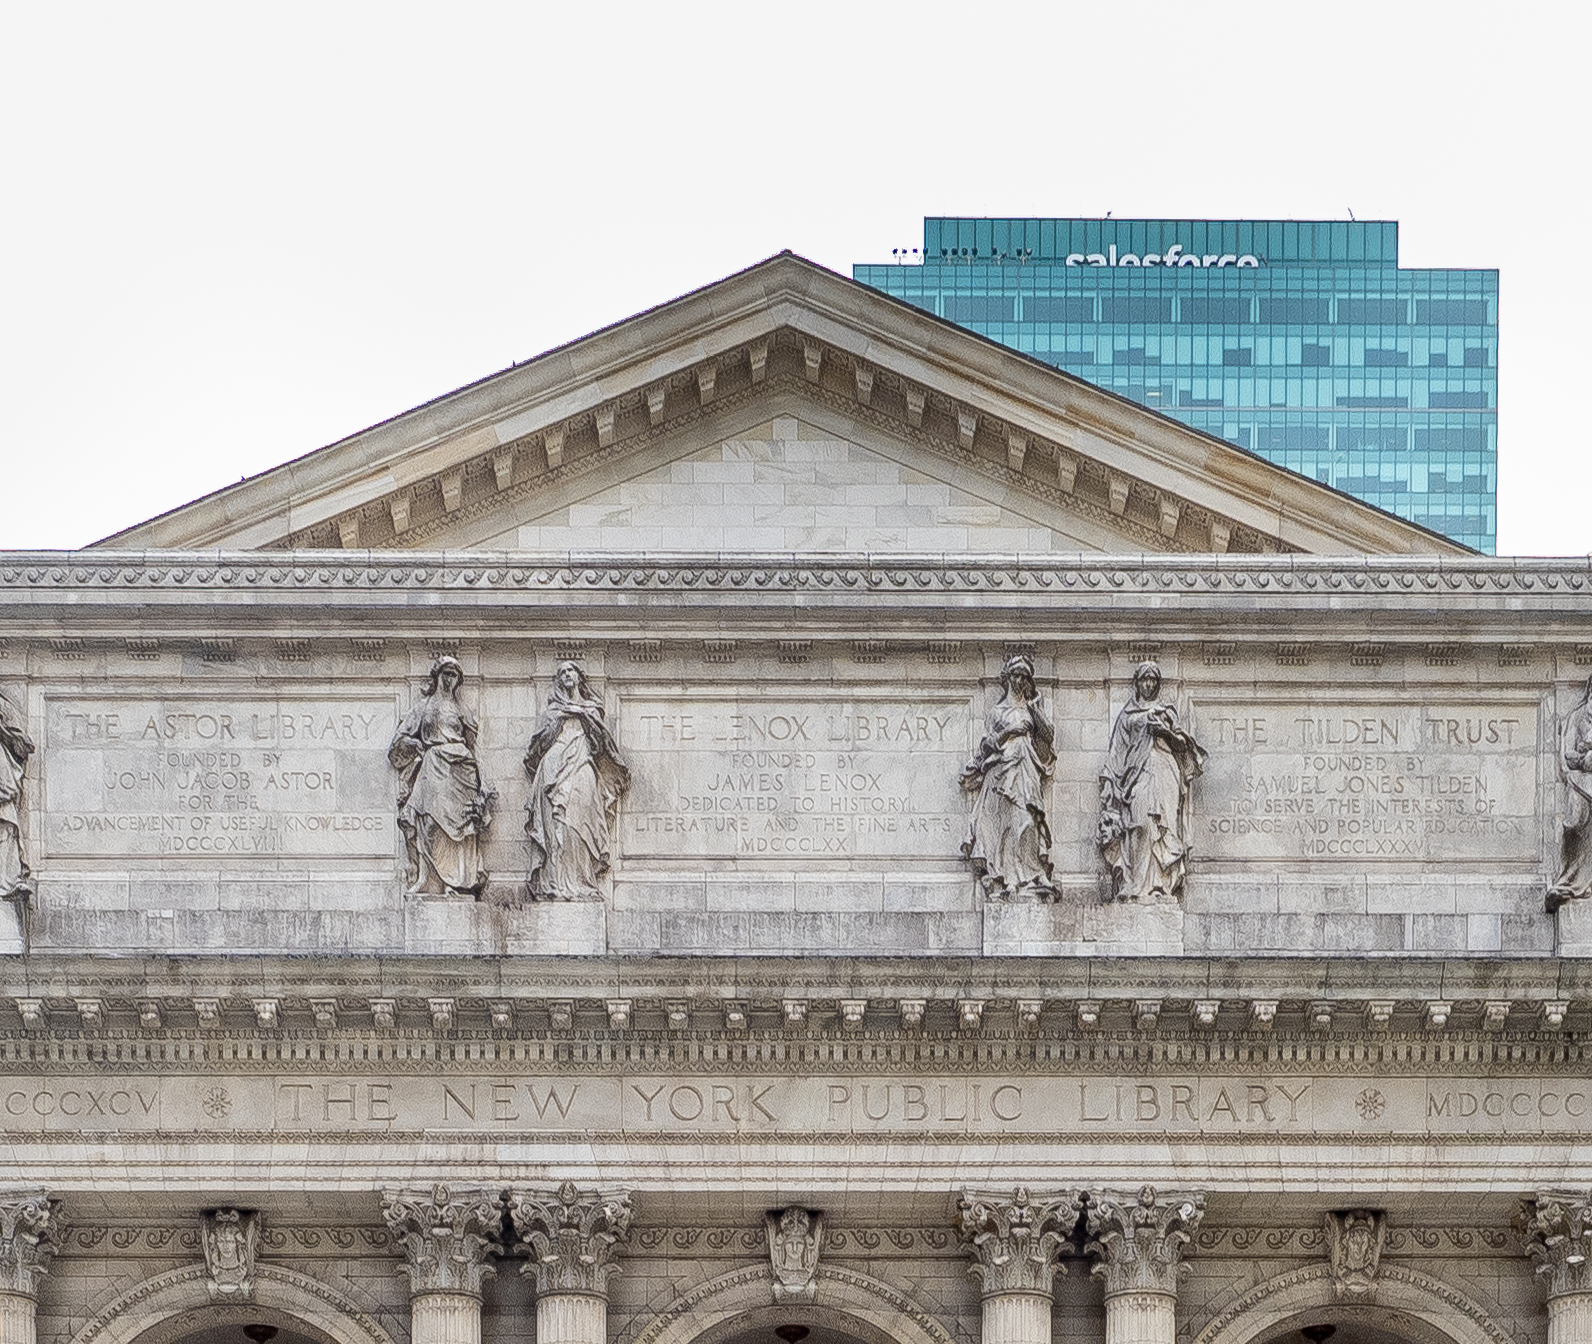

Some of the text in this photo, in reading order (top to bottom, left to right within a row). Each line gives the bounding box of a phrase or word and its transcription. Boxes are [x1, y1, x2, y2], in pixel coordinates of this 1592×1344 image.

[1065, 244, 1259, 267] salesforce
[65, 714, 377, 740] THE ASTOR LIBRARY
[640, 716, 951, 742] THE LENOX LIBRARY
[1211, 718, 1520, 745] THE TILDEN TRUST
[158, 752, 283, 768] FOUNDED BY
[731, 754, 858, 769] FOUNDED BY
[1303, 757, 1426, 772] FOUNDED BY
[104, 772, 334, 791] JOHN JACOB ASTOR
[708, 773, 882, 792] JAMES LENOX
[1245, 776, 1488, 795] SAMUEL JONES TILDEN
[179, 795, 258, 811] FOR THE
[680, 797, 779, 812] DEDICATED
[792, 797, 815, 812] TO
[1230, 799, 1496, 815] TO SERVE THE INTERESTS OF
[60, 816, 384, 832] ADVANCEMENT OF USEFUL KNOWLEDGE
[635, 818, 952, 833] LITERATURE AND THE FINE ARTS
[1208, 819, 1524, 835] SCIENCE AND POPULAR EDUCATION
[741, 837, 847, 853] MDCCCLXX
[281, 1085, 398, 1122] THE
[442, 1085, 580, 1122] NEW
[632, 1085, 779, 1122] YORK
[828, 1085, 1023, 1122] PUBLIC
[1078, 1085, 1311, 1122] LIBRARY
